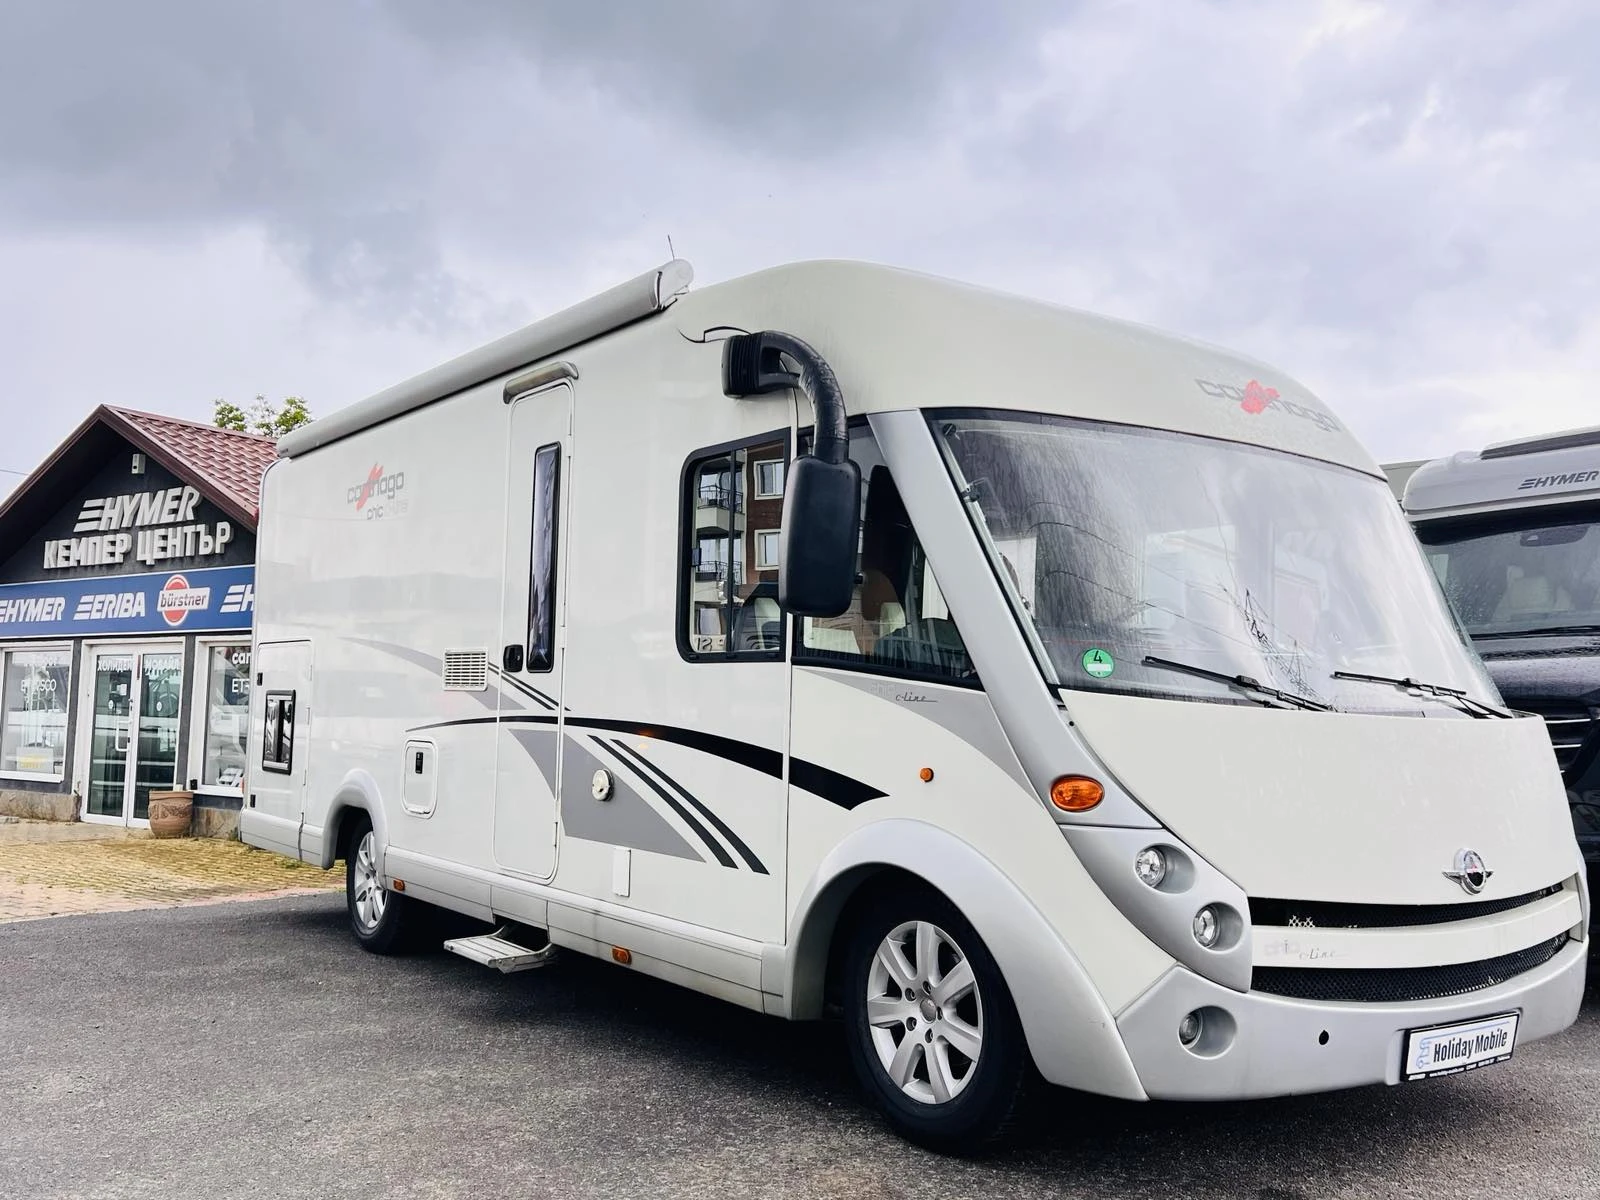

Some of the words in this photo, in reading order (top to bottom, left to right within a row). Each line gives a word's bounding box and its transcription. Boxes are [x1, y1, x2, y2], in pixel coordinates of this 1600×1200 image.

[1533, 471, 1599, 489] HYMER
[98, 486, 199, 531] HYMER
[43, 533, 132, 569] КЕМПЕР
[137, 521, 234, 565] ЦЕНТЪР
[3, 597, 66, 623] HYMER
[91, 592, 146, 620] ERIBA
[160, 593, 207, 608] bürstner
[1093, 650, 1103, 664] 4
[1433, 1037, 1475, 1063] Holiday
[1474, 1028, 1508, 1054] Mobile
